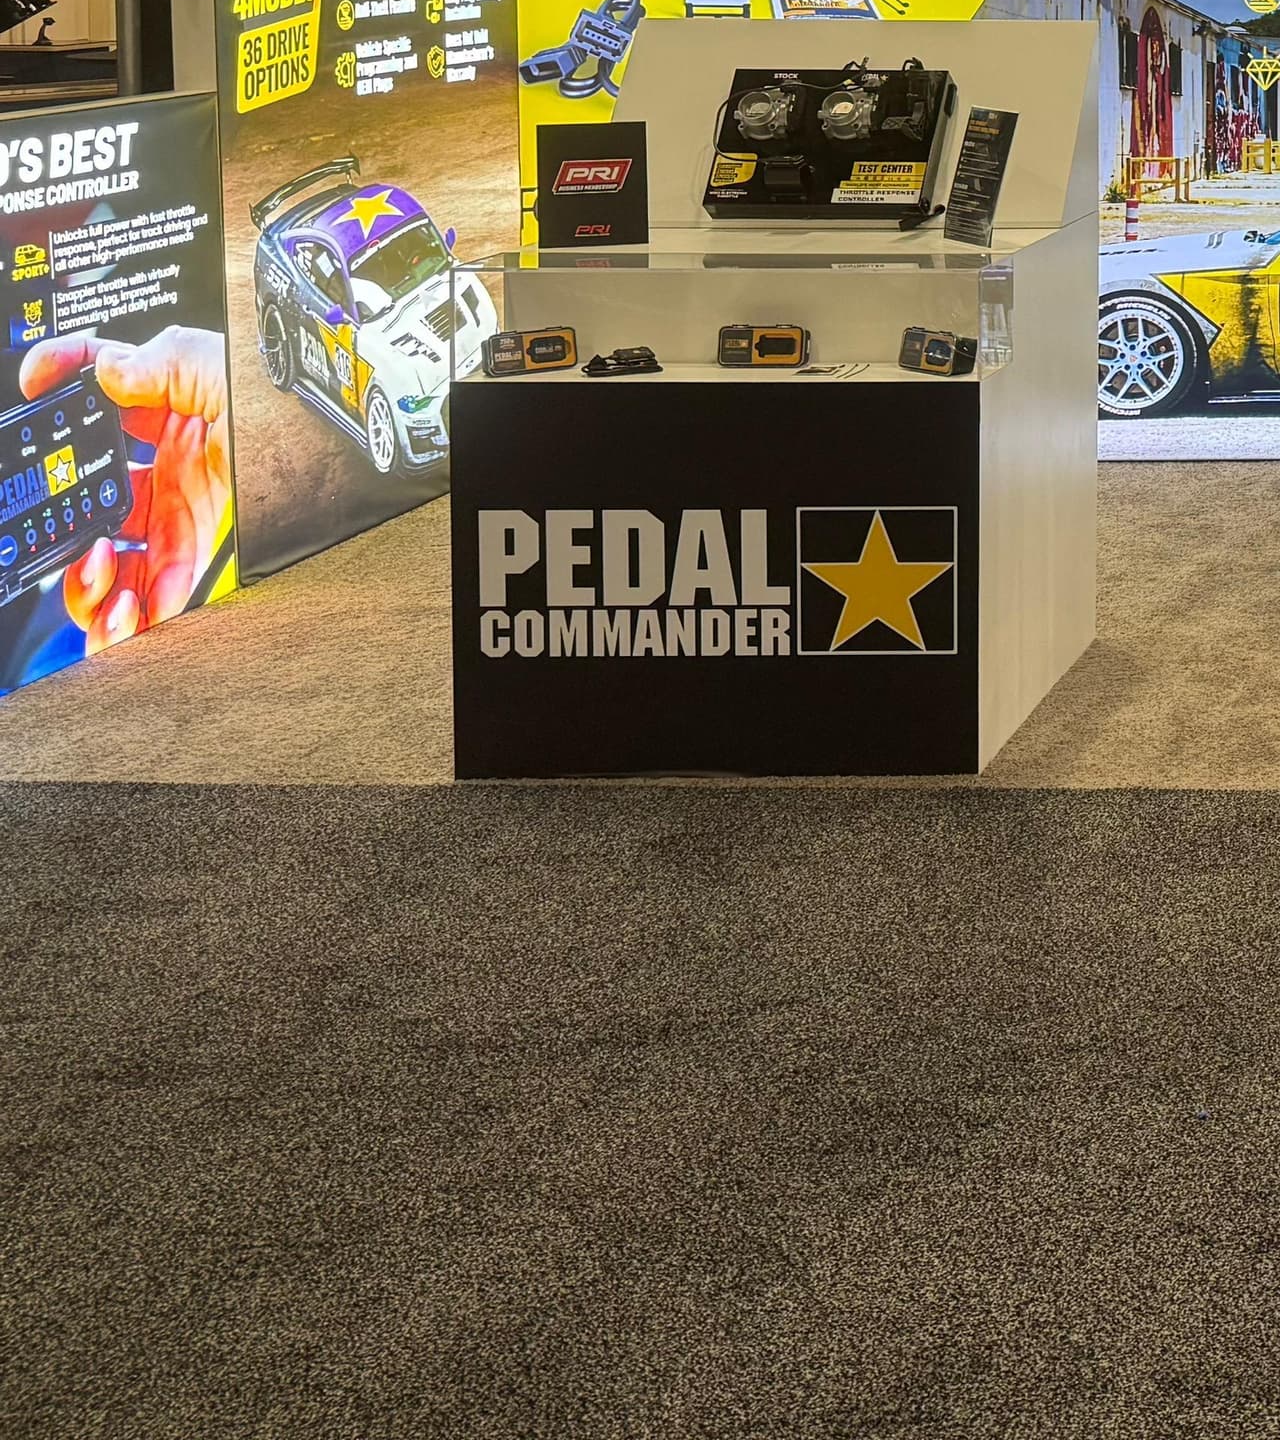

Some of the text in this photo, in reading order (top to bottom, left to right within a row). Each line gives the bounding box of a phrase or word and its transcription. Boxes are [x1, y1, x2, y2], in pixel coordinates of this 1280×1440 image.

[243, 22, 310, 67] 36 DRIVE
[245, 55, 309, 100] OPTIONS
[49, 122, 139, 179] BEST
[858, 164, 914, 174] TEST CENTER
[46, 170, 139, 206] CONTROLLER
[564, 165, 620, 182] PRI
[574, 224, 612, 236] PRI
[22, 325, 47, 342] CITY
[478, 509, 791, 607] PEDAL
[479, 608, 791, 659] COMMANDER
